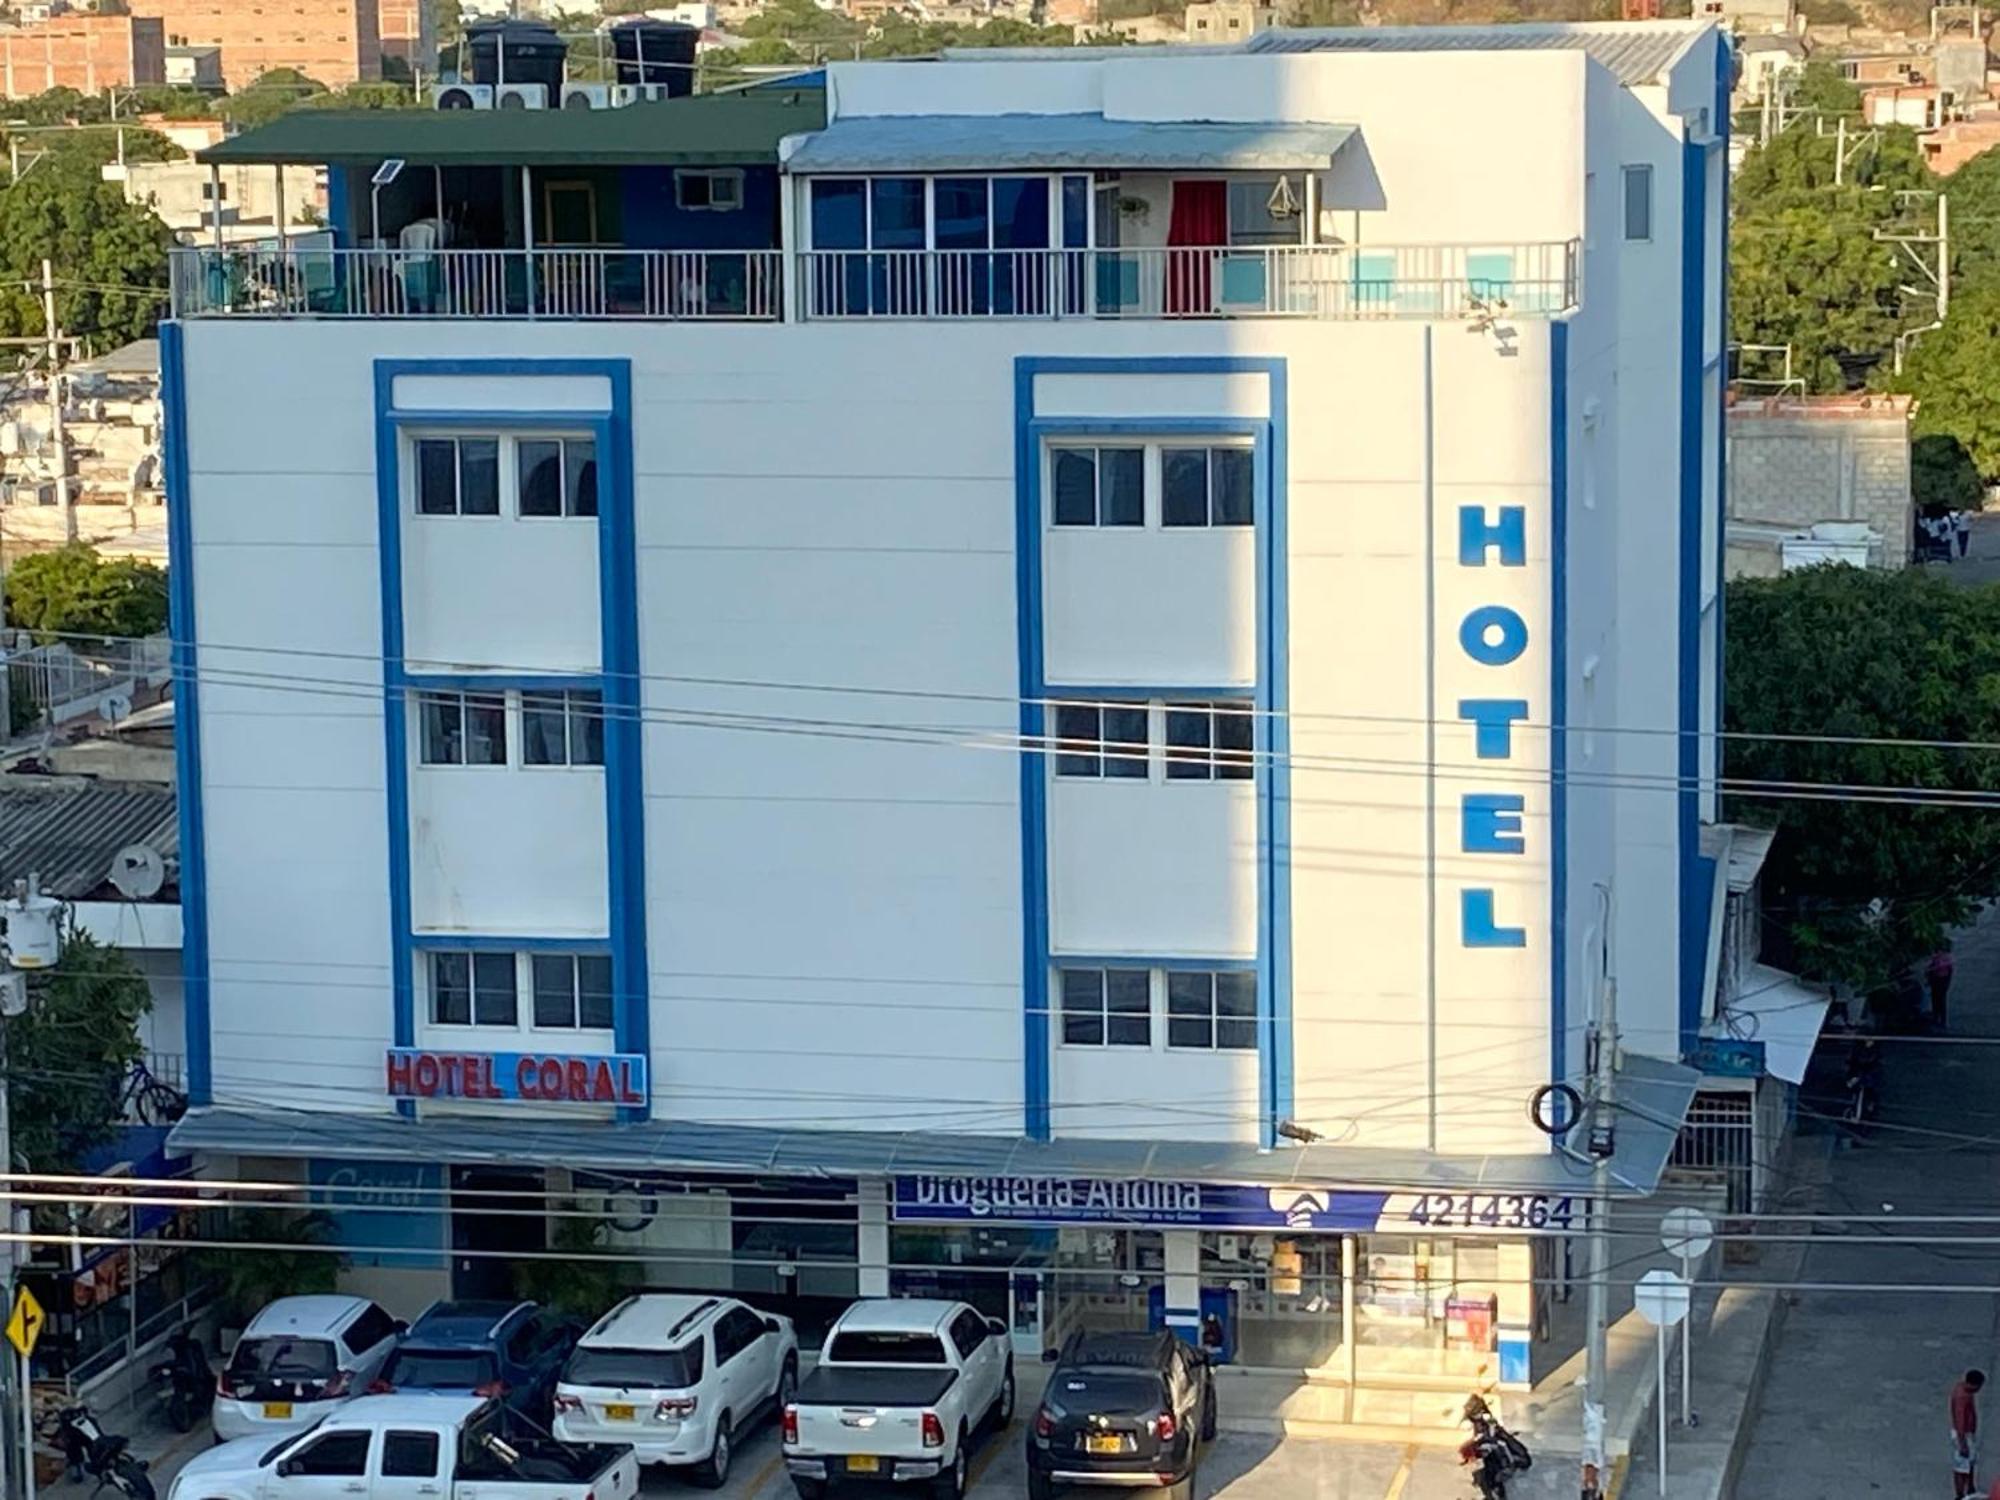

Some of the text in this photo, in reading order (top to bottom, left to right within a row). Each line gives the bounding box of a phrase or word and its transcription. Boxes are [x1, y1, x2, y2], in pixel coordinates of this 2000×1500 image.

[1458, 505, 1529, 948] HOTEL
[386, 1054, 644, 1103] HOTEL CORAL
[1088, 1177, 1200, 1210] Andina
[1408, 1194, 1573, 1230] 4214364
